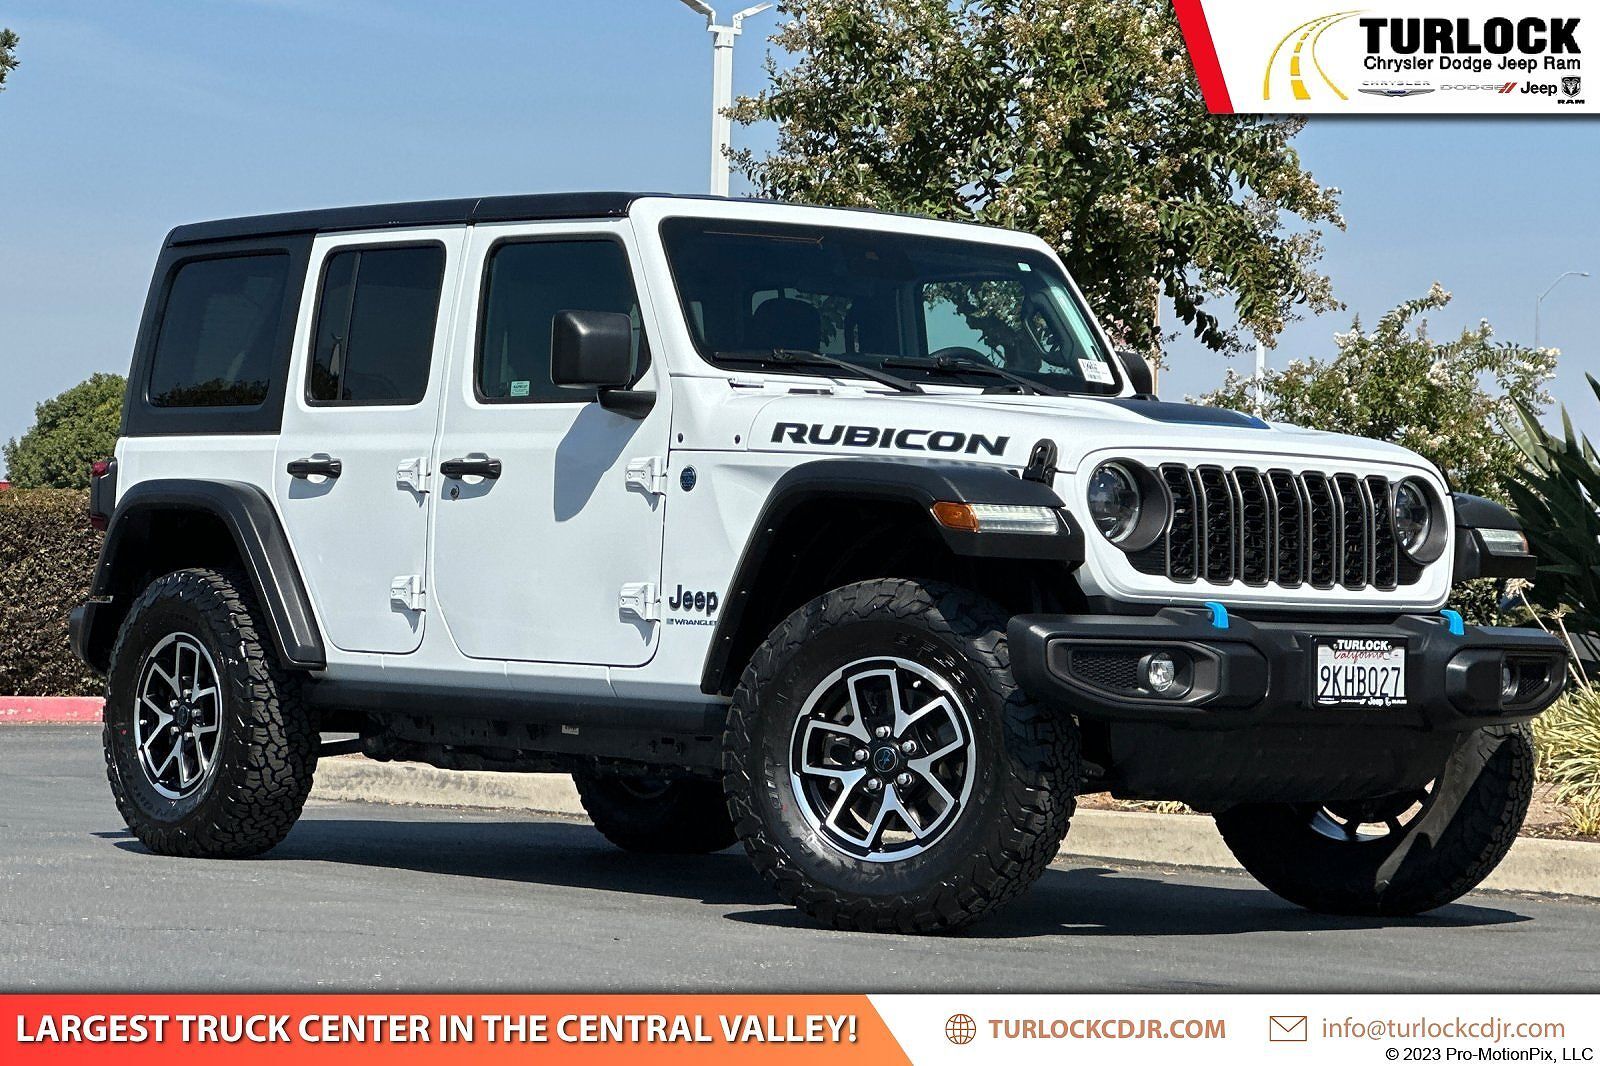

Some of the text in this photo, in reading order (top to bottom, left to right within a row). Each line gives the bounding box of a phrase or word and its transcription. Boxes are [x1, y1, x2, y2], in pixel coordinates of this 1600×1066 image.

[770, 421, 1011, 457] RUBICON
[668, 584, 719, 617] Jeep
[1337, 639, 1389, 651] TURLOCK
[1319, 665, 1401, 697] 9KHB027
